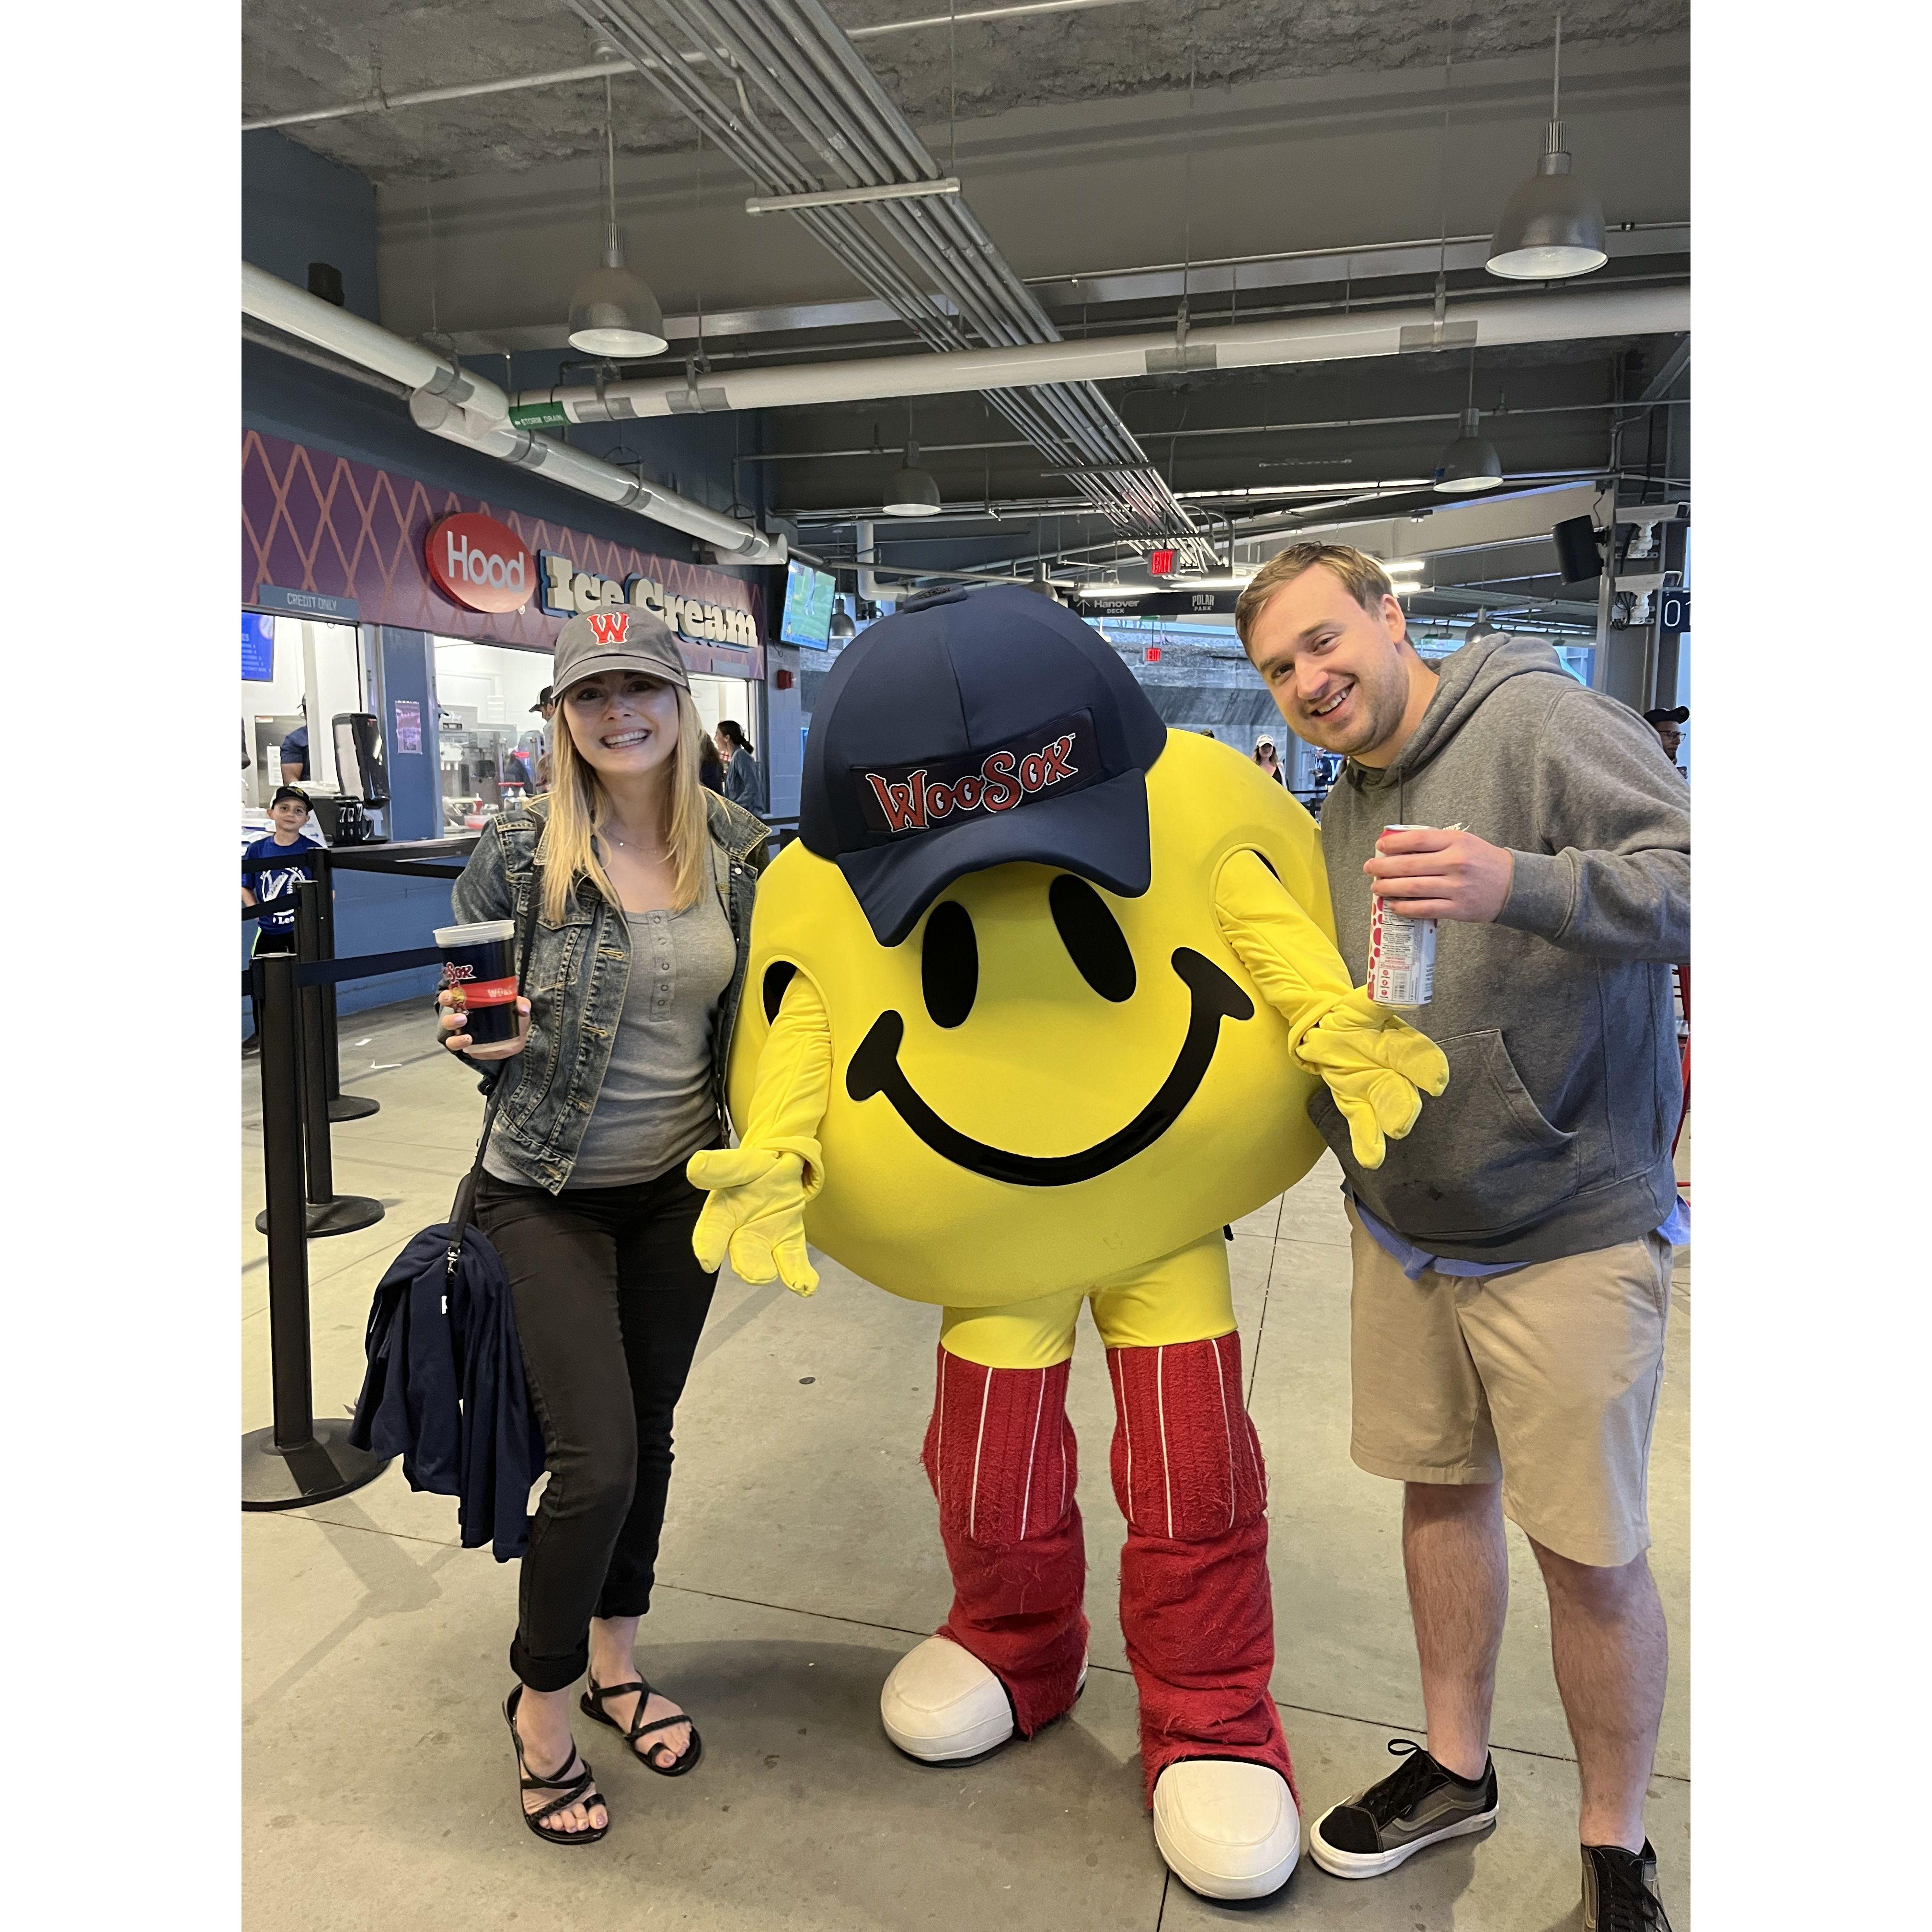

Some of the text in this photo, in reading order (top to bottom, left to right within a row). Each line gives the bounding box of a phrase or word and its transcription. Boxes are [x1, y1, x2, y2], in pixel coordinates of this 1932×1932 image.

[447, 530, 524, 593] Hood
[1152, 551, 1173, 573] EXIT
[287, 593, 336, 611] CREDIT ONLY
[545, 556, 758, 648] Ice Cream
[1094, 600, 1139, 608] Hanover
[1192, 594, 1214, 607] POLAR
[586, 611, 630, 645] W
[866, 734, 1079, 833] WooSox
